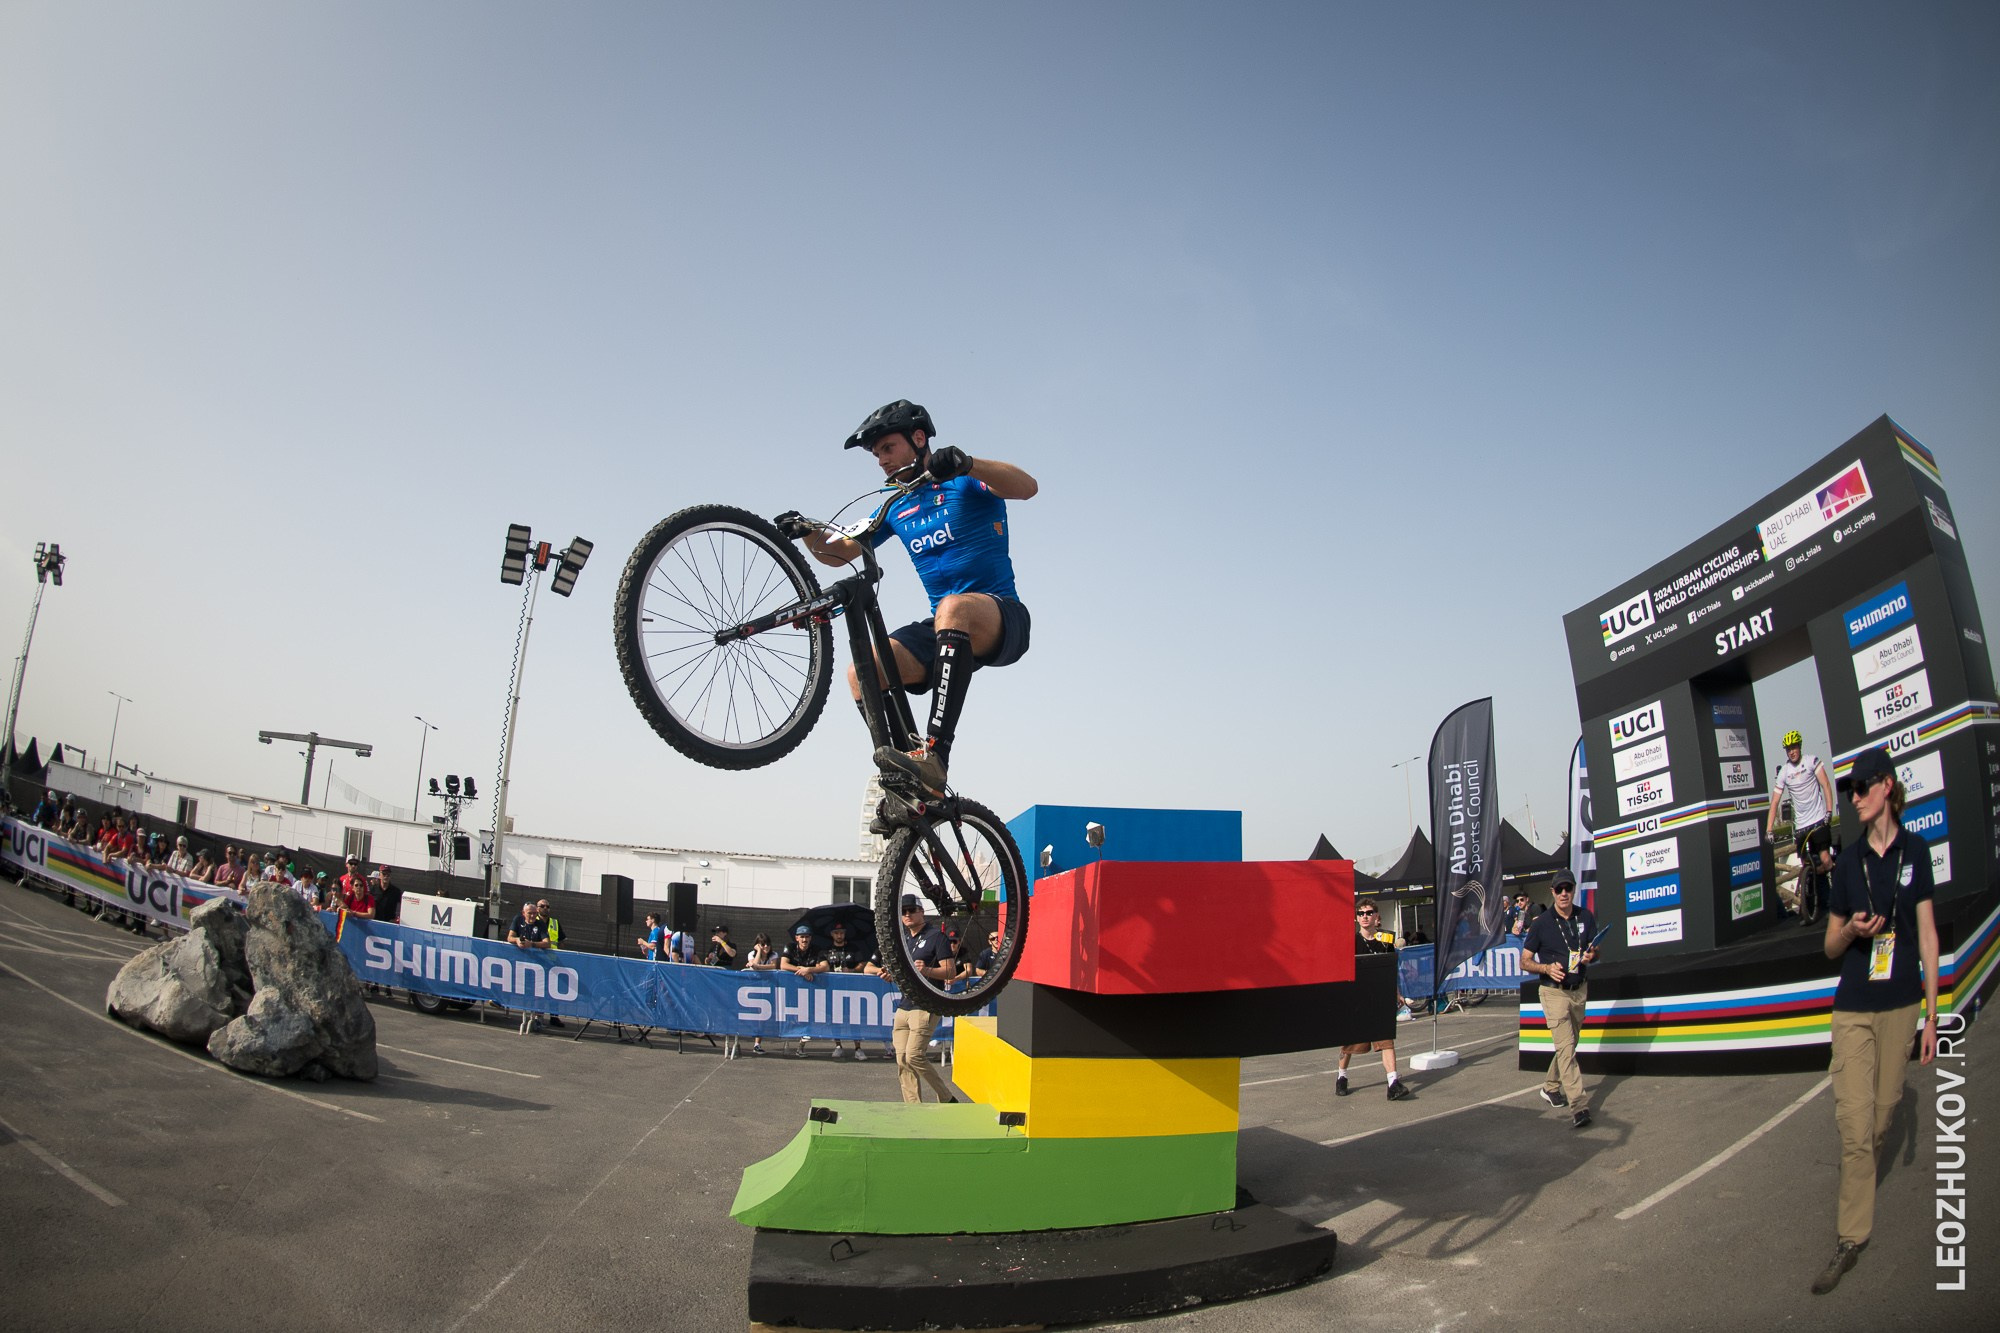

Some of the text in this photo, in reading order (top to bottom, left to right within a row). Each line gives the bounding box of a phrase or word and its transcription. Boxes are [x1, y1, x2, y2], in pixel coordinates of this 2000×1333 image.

[904, 508, 949, 531] ITALIA
[1765, 501, 1813, 538] ABU DHABI
[1842, 512, 1876, 536] uci_cycling
[910, 522, 955, 553] enel
[1769, 532, 1788, 550] UAE
[1795, 544, 1822, 564] uci_trials
[1653, 546, 1740, 602] 2024 URBAN CYCLING
[1655, 549, 1760, 614] WORLD CHAMPIONSHIPS
[1743, 570, 1775, 593] ucichannel
[1608, 598, 1650, 635] UCI
[1696, 601, 1722, 618] UCI Trials
[1849, 595, 1907, 635] SHIMANO
[1652, 623, 1678, 640] UCI_Trials
[1715, 607, 1773, 655] START
[1879, 636, 1913, 660] Abu Dhabi
[1880, 646, 1915, 668] Sports Council
[931, 662, 952, 728] hebo
[1874, 691, 1919, 720] TISSOT
[1713, 705, 1742, 715] SHIMANO
[1620, 709, 1656, 737] UCI
[1633, 744, 1662, 760] Abu Dhabi
[1889, 730, 1916, 752] UCI
[1726, 774, 1749, 784] TISSOT
[1627, 789, 1663, 807] TISSOT
[1734, 799, 1748, 811] UCI
[1443, 763, 1467, 875] Abu Dhabi
[1463, 760, 1483, 874] Sports Council
[1637, 818, 1658, 834] UCI
[1904, 810, 1943, 833] MANO
[11, 826, 45, 866] UCI
[1645, 847, 1671, 858] tadweer
[1646, 856, 1665, 867] group
[1731, 860, 1760, 877] SHIMANO
[1932, 854, 1944, 867] abi
[127, 870, 178, 916] UCI
[1628, 884, 1677, 903] SHIMANO
[365, 935, 579, 1001] SHIMANO
